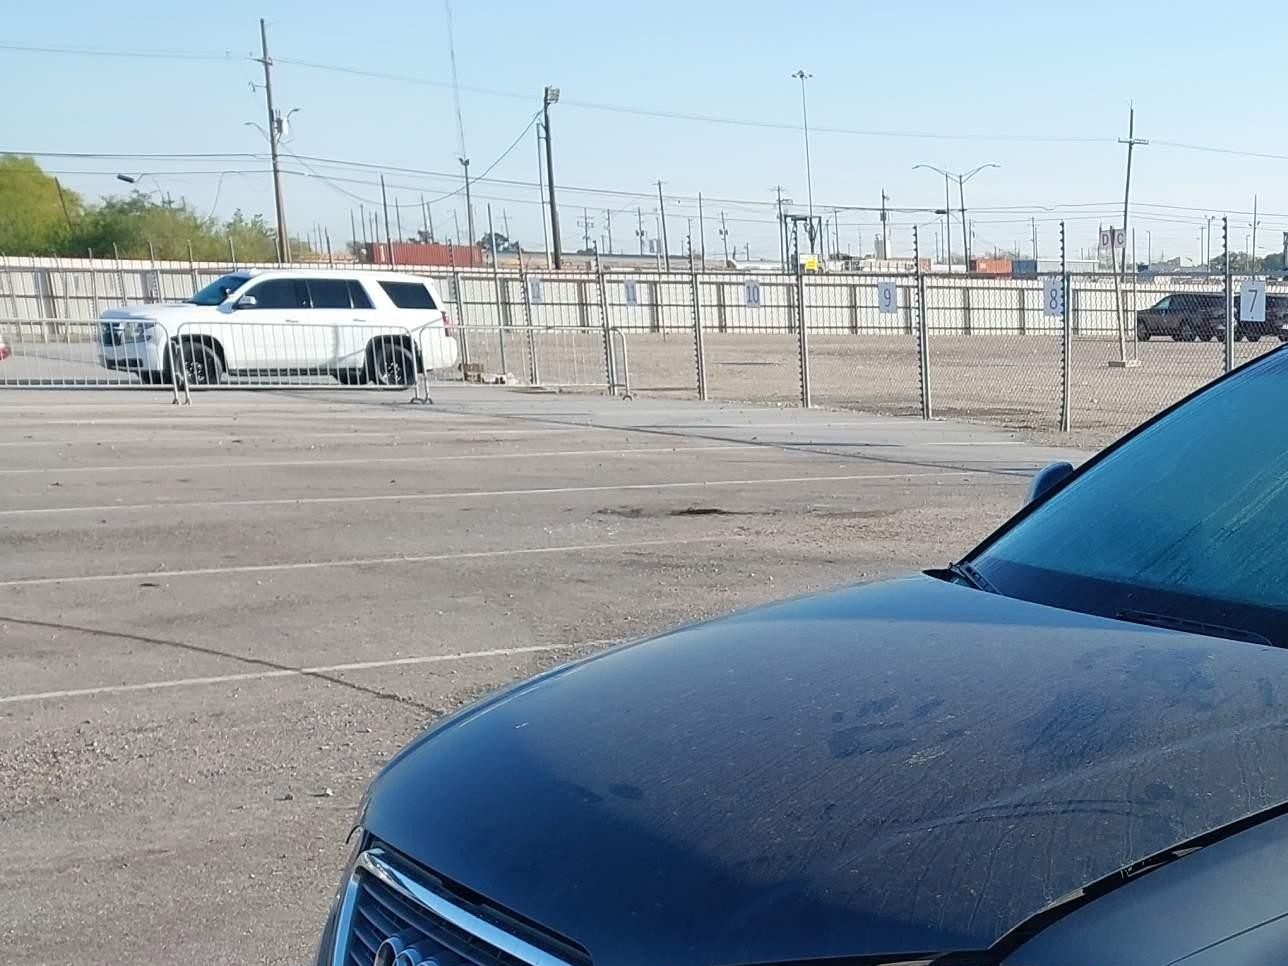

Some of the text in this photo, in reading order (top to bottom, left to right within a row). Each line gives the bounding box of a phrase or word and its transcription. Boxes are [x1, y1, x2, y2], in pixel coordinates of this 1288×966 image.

[1102, 232, 1124, 245] D C
[746, 285, 760, 303] 10
[883, 287, 891, 307] 9
[1049, 288, 1058, 310] 8
[1247, 289, 1258, 313] 7
